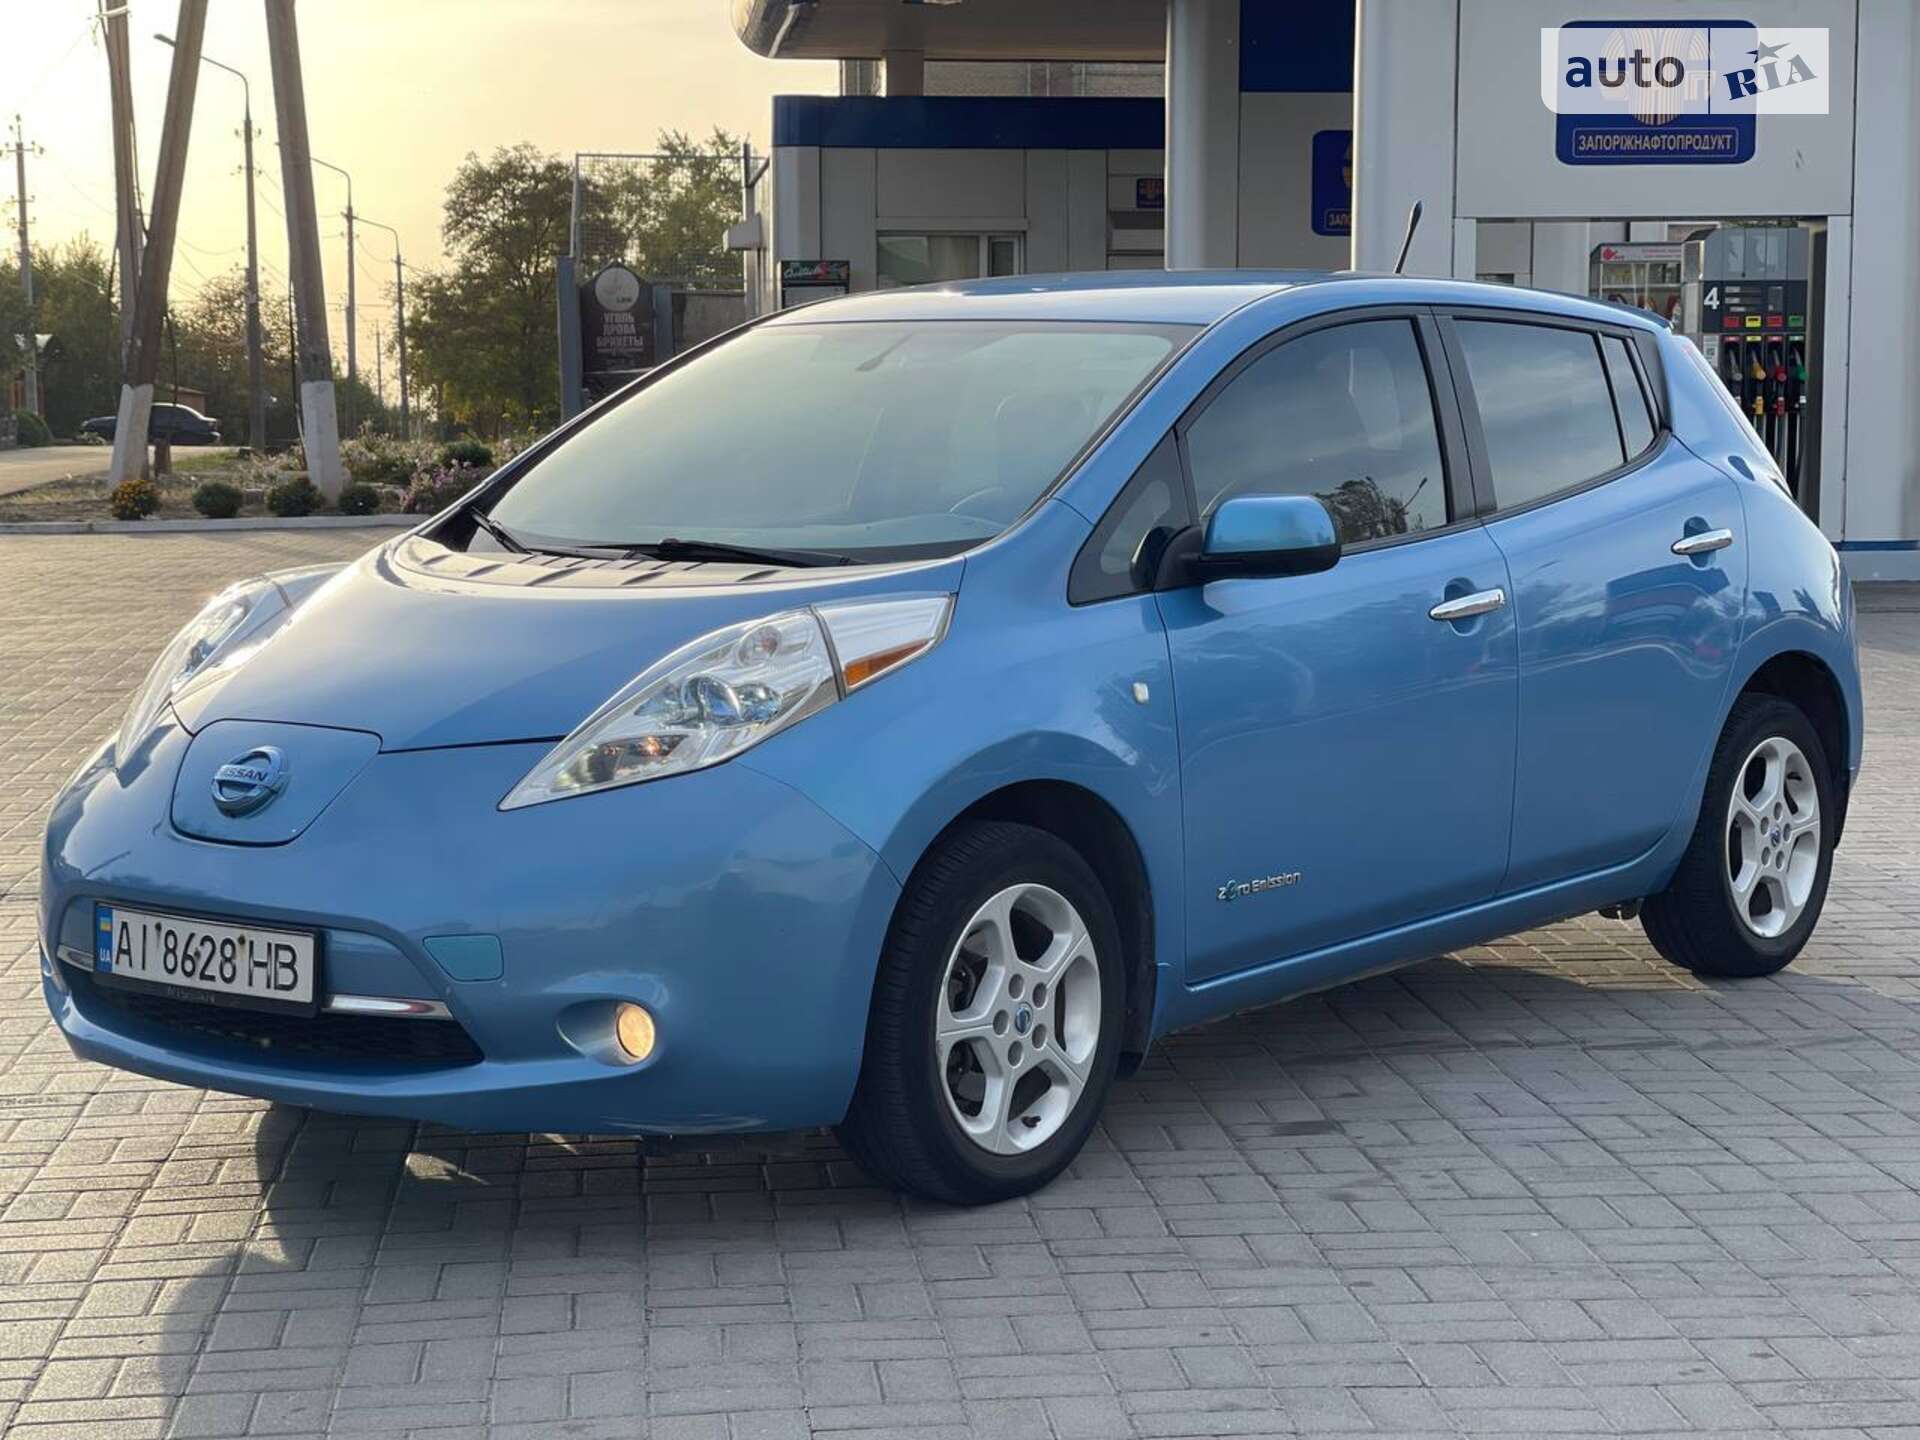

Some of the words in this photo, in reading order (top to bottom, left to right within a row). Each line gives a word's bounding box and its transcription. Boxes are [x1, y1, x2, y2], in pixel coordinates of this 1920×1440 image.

[1578, 134, 1733, 151] ЗАПОРІЖНАФТОПРОДУКТ
[1703, 286, 1720, 310] 4
[603, 312, 635, 323] УГОЛЬ
[603, 324, 636, 336] ДРОВА
[219, 766, 268, 782] NISSAN
[99, 948, 111, 963] UA
[115, 921, 147, 970] AI
[163, 929, 237, 985] 8628
[248, 940, 299, 991] HB
